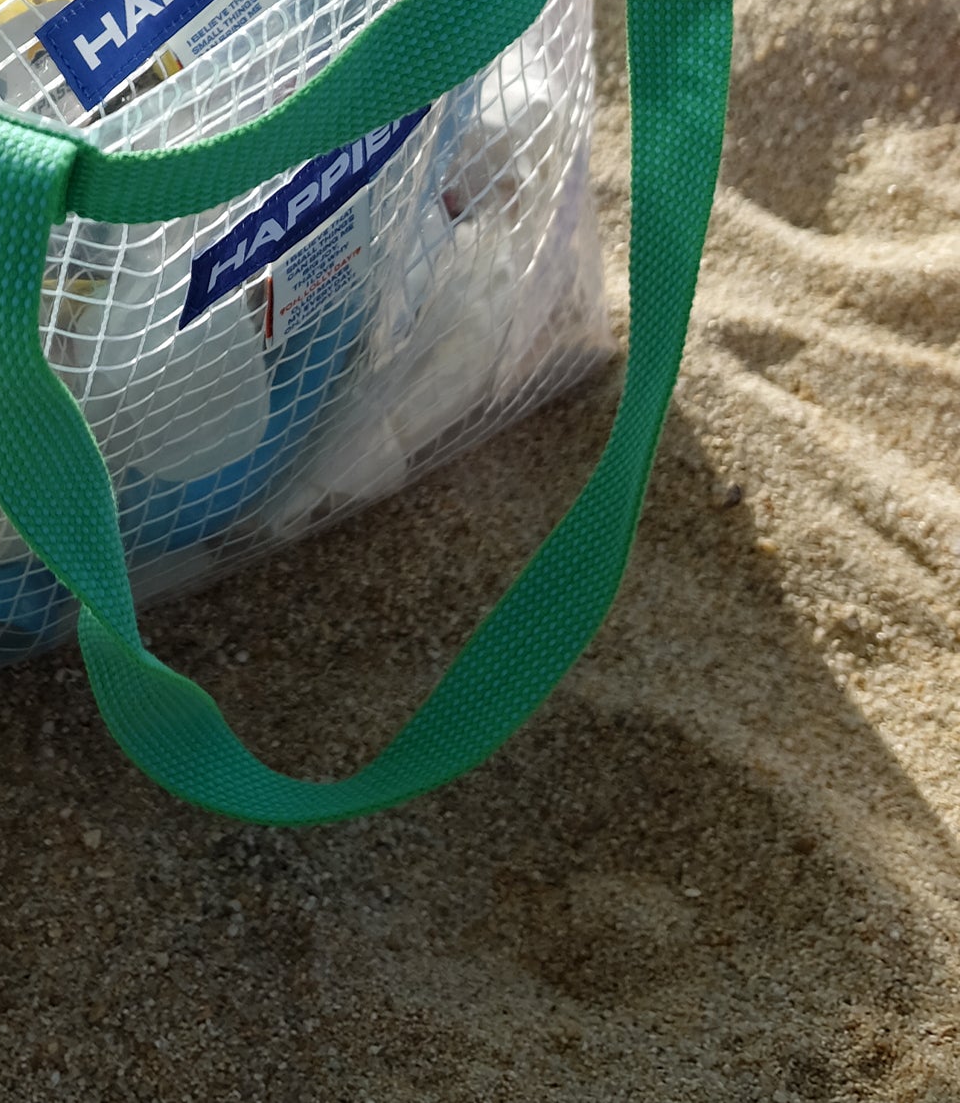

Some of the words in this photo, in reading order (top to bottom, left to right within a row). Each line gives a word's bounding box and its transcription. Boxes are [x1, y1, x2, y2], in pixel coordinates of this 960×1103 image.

[190, 7, 230, 43] BELIEVE
[247, 2, 262, 19] ME
[191, 27, 224, 55] SMALL
[207, 119, 400, 293] HAPPIE
[286, 247, 318, 275] SMALL
[319, 214, 355, 247] THINGS
[287, 260, 308, 282] CAN
[309, 236, 339, 263] BRING
[340, 222, 354, 238] ME
[290, 228, 329, 263] BELIEVE
[330, 205, 354, 229] THAT
[303, 268, 333, 297] LOLLY
